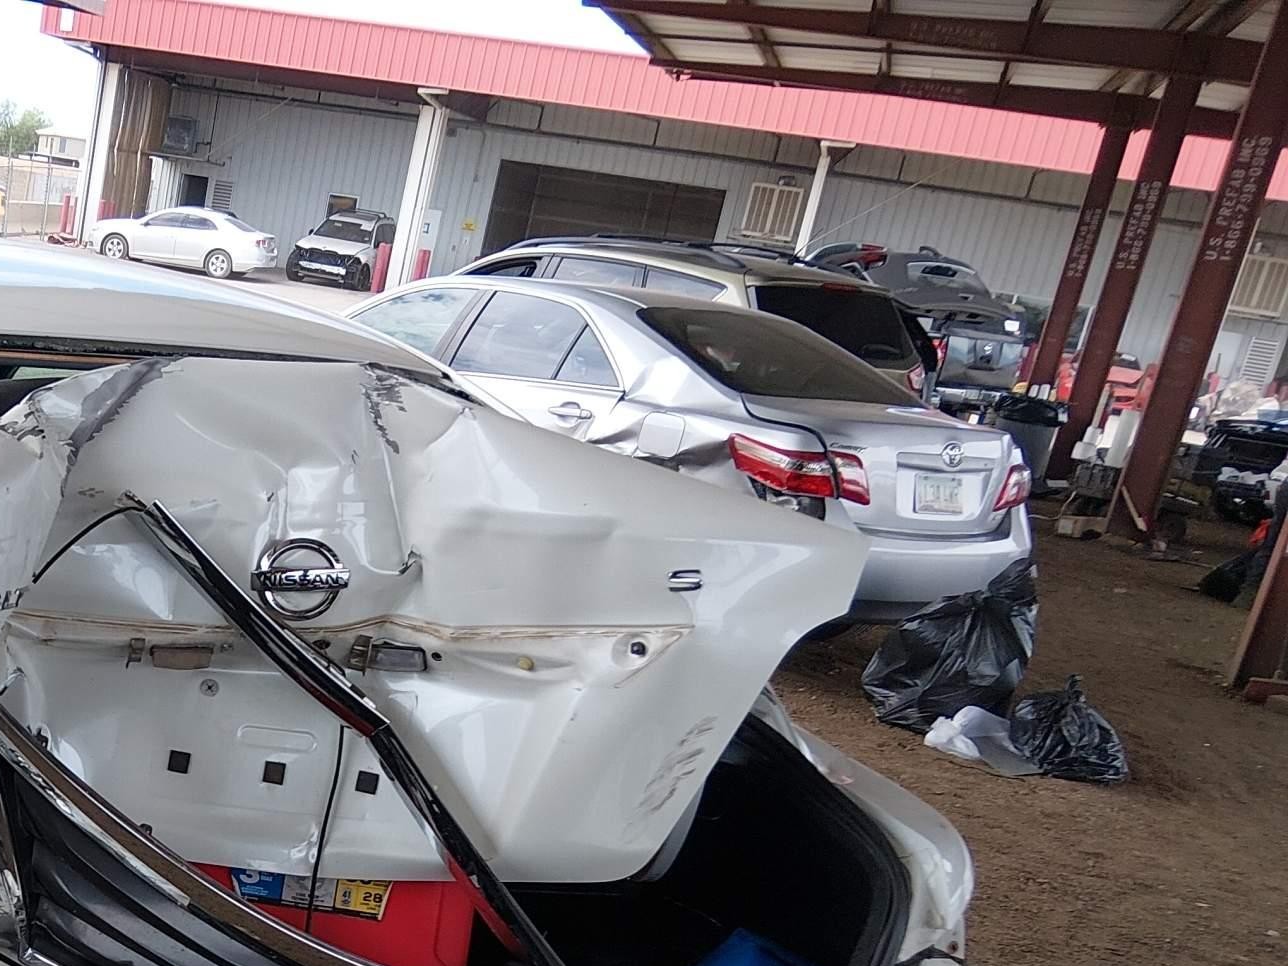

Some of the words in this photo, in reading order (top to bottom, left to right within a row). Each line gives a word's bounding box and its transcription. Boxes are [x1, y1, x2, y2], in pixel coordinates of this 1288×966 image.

[1203, 232, 1226, 260] U.S.
[1216, 168, 1246, 226] PREFAB
[1219, 135, 1273, 260] 1-866-799-0969
[261, 571, 347, 588] NISSAN
[362, 891, 383, 904] 28
